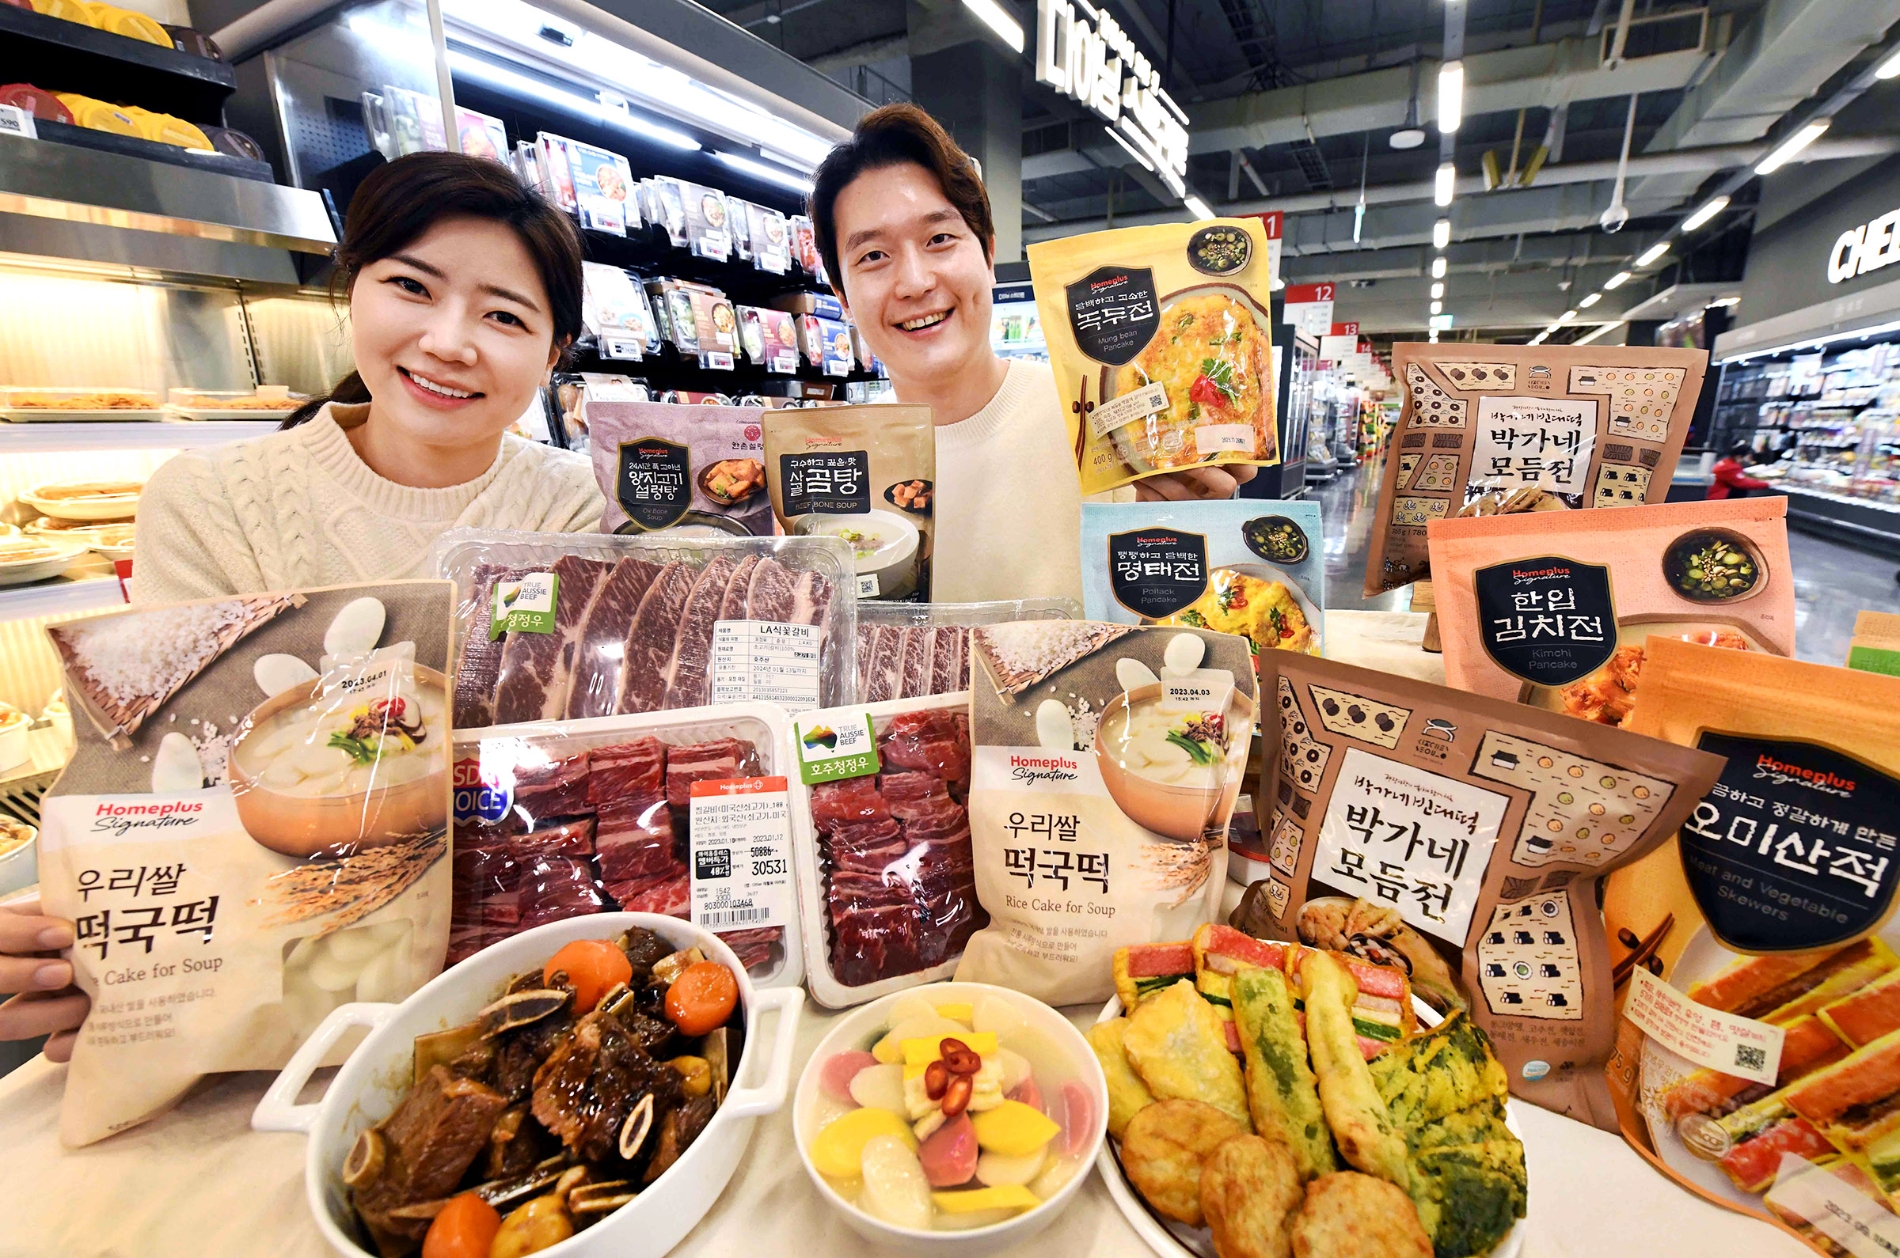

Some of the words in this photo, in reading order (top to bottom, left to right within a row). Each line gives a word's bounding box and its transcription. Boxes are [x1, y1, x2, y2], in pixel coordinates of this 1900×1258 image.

[1090, 275, 1128, 289] Homeplus
[1118, 290, 1148, 301] 고소한
[1315, 286, 1332, 301] 12
[1077, 300, 1153, 331] 녹두전
[1098, 334, 1118, 345] Mung
[1119, 330, 1138, 339] bean
[1345, 324, 1357, 335] 13
[1103, 340, 1134, 352] Pancake
[1361, 345, 1371, 353] 14
[1536, 412, 1582, 427] 빈대떡
[806, 440, 842, 450] Signature
[1490, 428, 1581, 455] 박가네
[628, 462, 651, 470] 24시간
[790, 458, 824, 468] 구수하고
[847, 457, 857, 466] 맛
[1093, 455, 1106, 466] 400
[628, 471, 683, 486] 양지고기
[1484, 457, 1574, 485] 모듬전
[636, 484, 678, 500] 설렁탕
[814, 500, 834, 508] BONE
[1136, 536, 1178, 544] Homeplus
[1165, 551, 1198, 562] 담백한
[1117, 560, 1200, 581] 명태전
[1512, 566, 1570, 578] Homeplus
[1513, 572, 1572, 586] Signature
[522, 588, 547, 596] AUSSIE
[1140, 596, 1177, 604] Pancake
[1142, 588, 1175, 596] Pollack
[1510, 587, 1576, 612] 한입
[1494, 614, 1604, 643] 김치전
[1532, 648, 1572, 660] Kimchi
[1528, 659, 1578, 670] Pancake
[342, 670, 387, 689] 2023.04.01
[1170, 688, 1210, 696] 2023.04.03
[840, 729, 865, 739] AUSSIE
[840, 737, 857, 746] BEEF
[810, 756, 869, 776] 호주청정우
[1010, 755, 1078, 771] Homeplus
[1011, 768, 1078, 786] Signature
[1758, 754, 1856, 791] Homeplus
[1752, 763, 1853, 799] Signature
[95, 801, 203, 817] Homeplus
[1354, 775, 1410, 807] 박가네
[1412, 796, 1479, 836] 빈대떡
[90, 816, 199, 836] Signature
[1003, 812, 1080, 842] 우리쌀
[1772, 801, 1850, 836] 정갈하게
[1854, 826, 1898, 851] 만든
[1346, 803, 1470, 882] 박가네
[1684, 801, 1890, 898] 오미산적
[752, 859, 788, 876] 30531
[1004, 846, 1110, 894] 떡국떡
[76, 863, 187, 903] 우리쌀
[1330, 846, 1454, 924] 모듬전
[1689, 856, 1718, 877] Meat
[1722, 868, 1754, 890] and
[1759, 882, 1849, 924] Vegetable
[1006, 895, 1028, 910] Rice
[1032, 898, 1062, 913] Cake
[1066, 900, 1085, 915] for
[1086, 902, 1116, 918] Soup
[1717, 886, 1790, 922] Skewers
[76, 896, 220, 961] 떡국떡
[1046, 926, 1060, 936] 쌀을
[1056, 941, 1078, 952] 만들어
[104, 967, 146, 987] Cake
[152, 962, 176, 979] for
[182, 956, 224, 976] Soup
